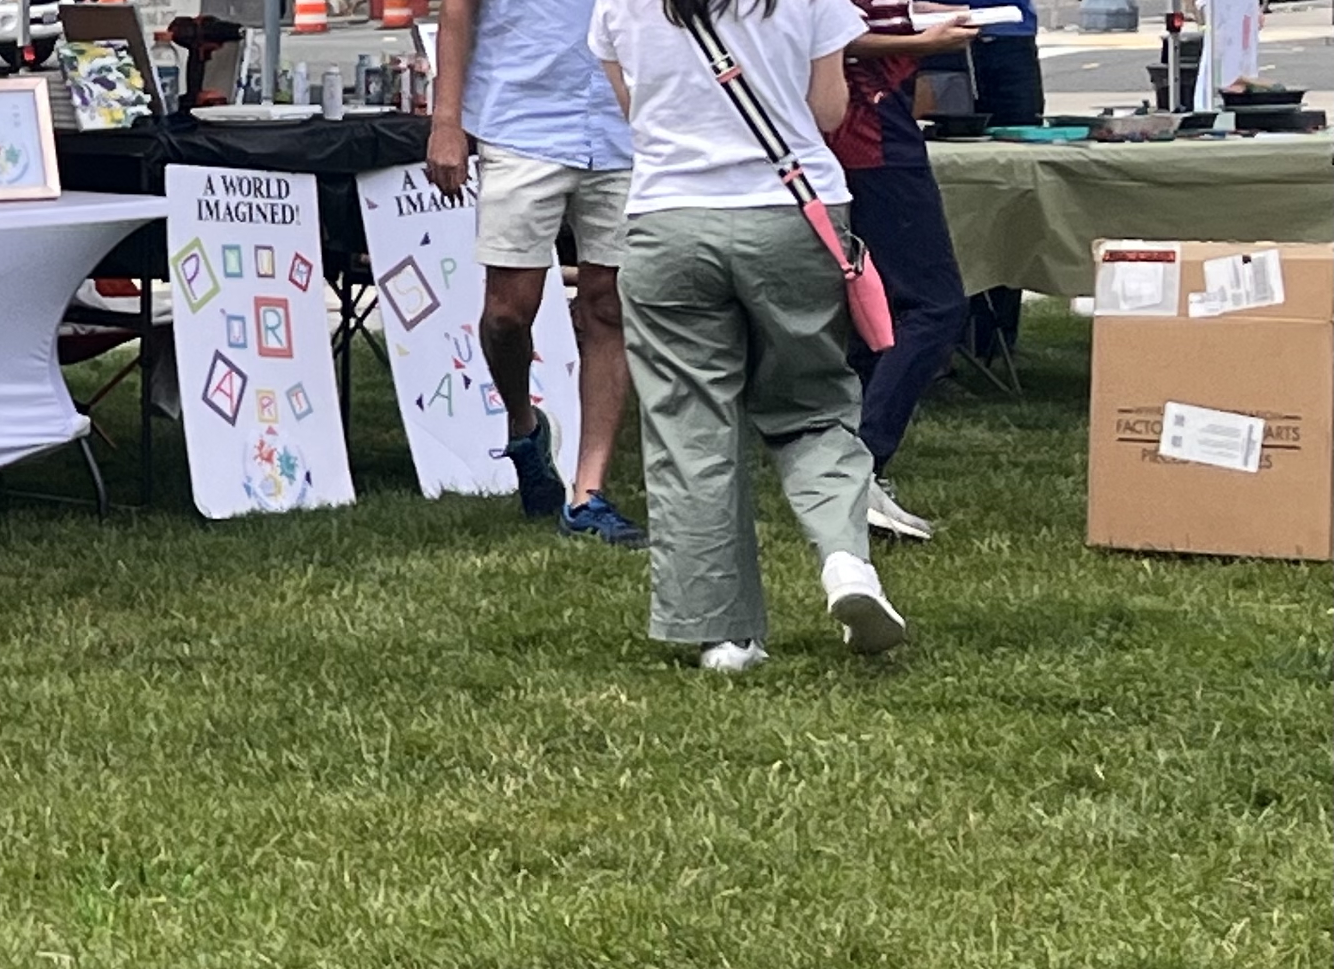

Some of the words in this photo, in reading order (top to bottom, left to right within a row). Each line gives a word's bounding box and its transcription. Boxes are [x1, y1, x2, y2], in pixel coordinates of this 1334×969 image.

[203, 175, 217, 197] A
[220, 175, 290, 200] WORLD
[401, 170, 418, 192] A
[196, 198, 301, 225] IMAGINED!
[1116, 418, 1164, 435] FACTO
[1262, 425, 1301, 442] ARTS
